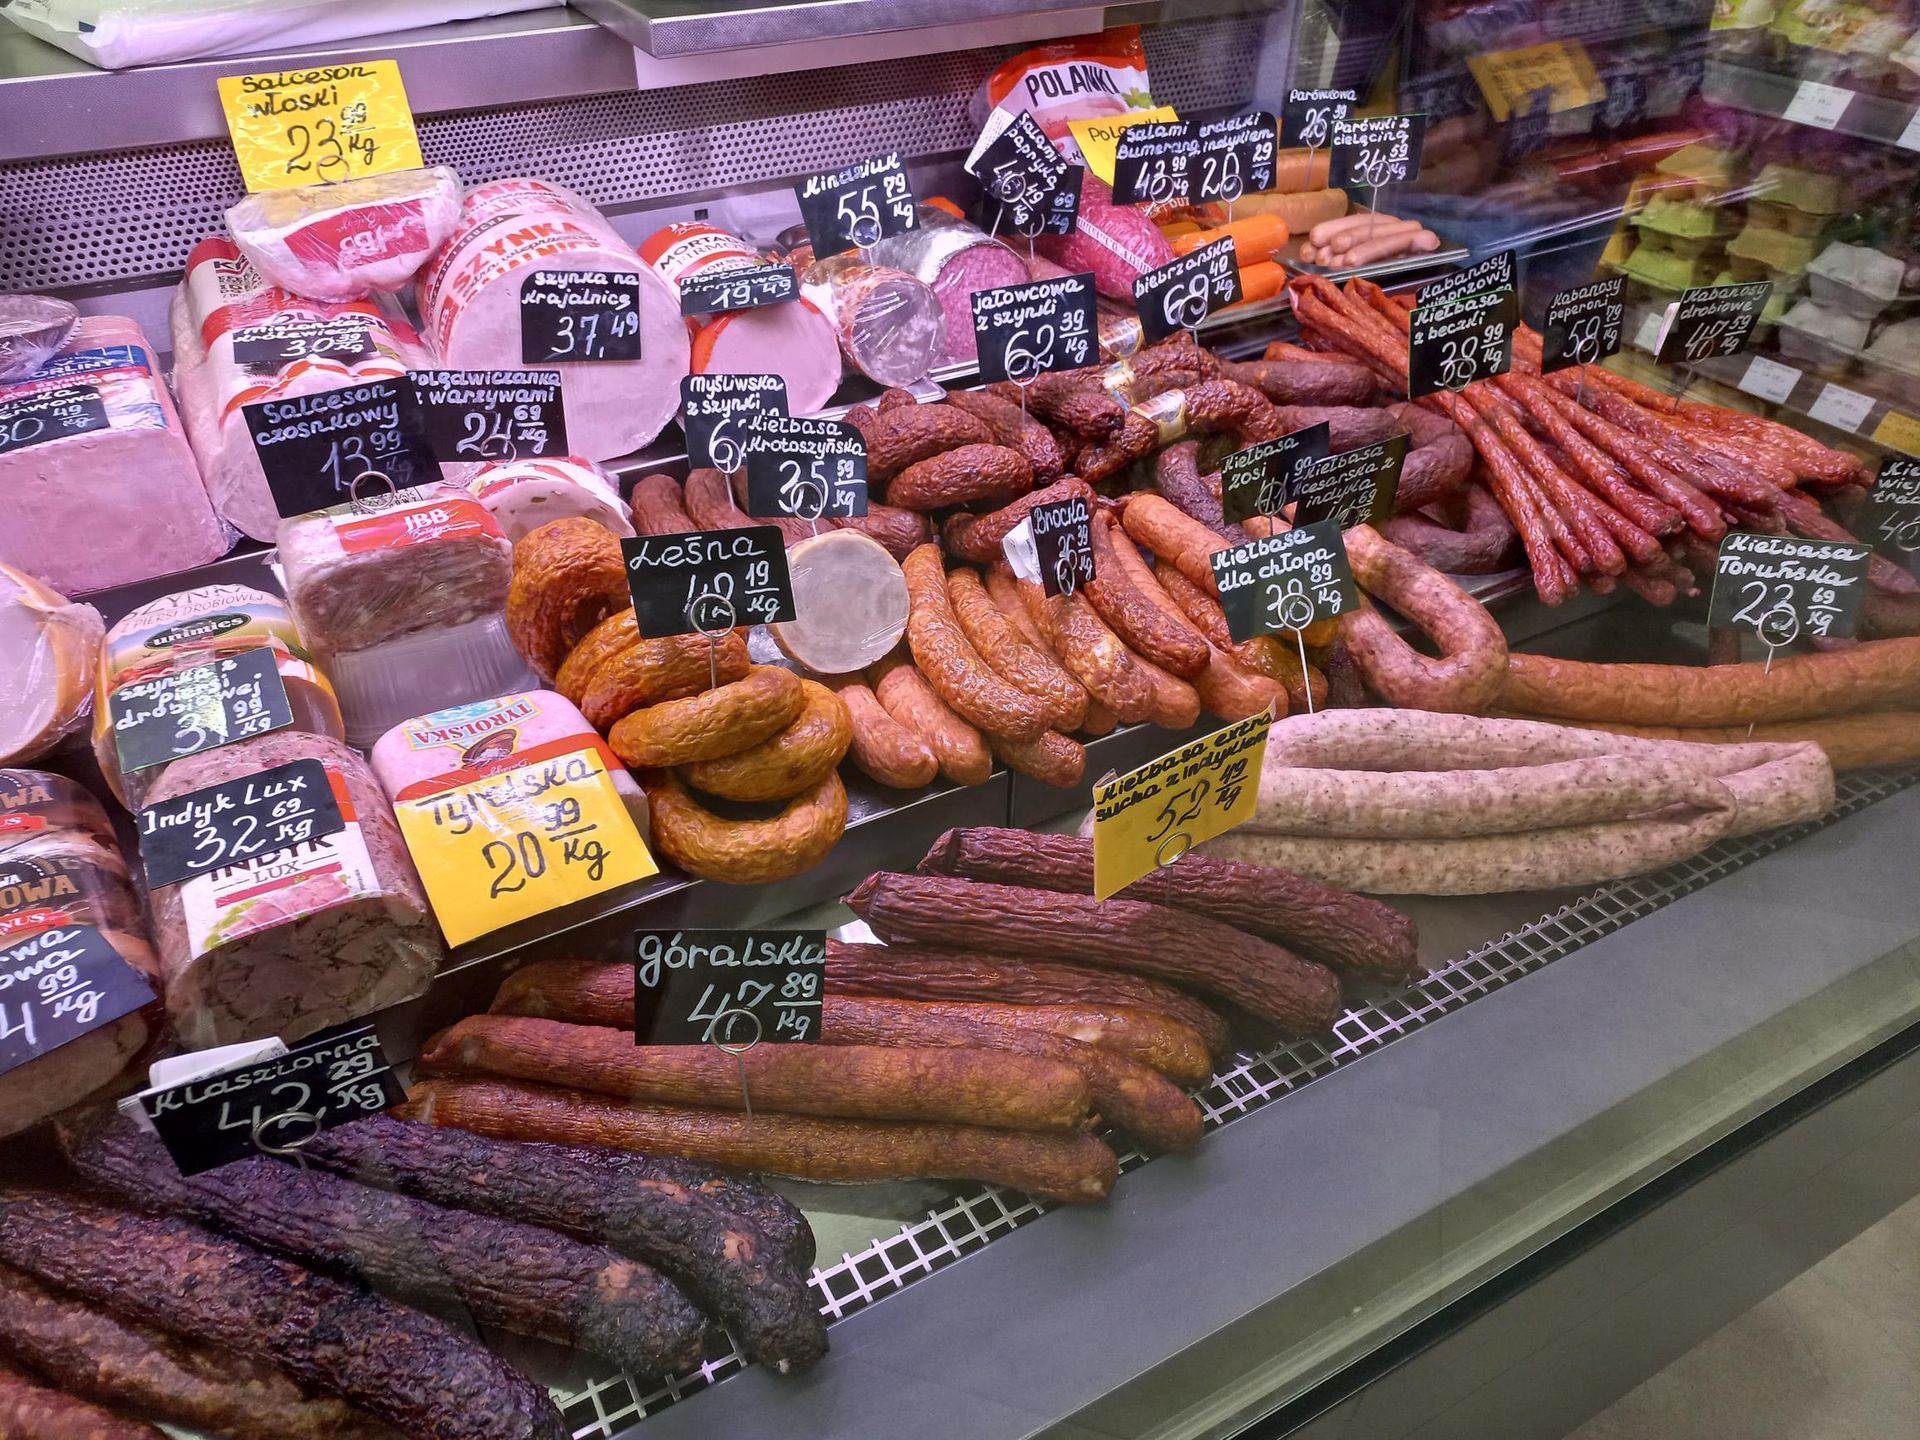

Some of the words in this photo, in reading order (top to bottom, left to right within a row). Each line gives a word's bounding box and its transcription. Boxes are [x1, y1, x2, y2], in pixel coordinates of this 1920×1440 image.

[242, 66, 377, 94] Salceson
[1025, 63, 1121, 107] POLANKI
[1019, 112, 1061, 165] Salami
[1127, 120, 1190, 143] Salami
[1199, 111, 1260, 138] erdelki
[1334, 116, 1397, 134] Parówki
[286, 118, 344, 174] 23
[1117, 140, 1200, 159] Bumerang
[1389, 143, 1409, 158] 59
[883, 173, 906, 198] 79
[1201, 151, 1240, 198] 20
[1253, 142, 1273, 163] 29
[452, 221, 583, 290] SZYNKA
[613, 273, 639, 286] na
[762, 279, 792, 294] 49
[1418, 252, 1509, 303] Kabanosy
[1551, 278, 1622, 308] Kabanosy
[1684, 284, 1768, 304] Kabanosy
[976, 316, 989, 332] z
[993, 299, 1058, 329] szynki
[1163, 273, 1209, 326] 69
[1414, 293, 1505, 327] Kiełbasa
[1548, 294, 1610, 327] peperoni
[1606, 304, 1622, 322] 79
[1680, 300, 1753, 320] drobiowe
[610, 311, 639, 338] 49
[1413, 331, 1424, 346] z
[1428, 311, 1487, 340] beczki
[1484, 323, 1504, 343] 99
[1729, 314, 1752, 330] 59
[1004, 324, 1056, 376] 62
[1059, 309, 1086, 332] 39
[53, 404, 83, 417] 49
[263, 384, 396, 424] Salceson
[429, 386, 555, 410] warzywami
[687, 401, 698, 416] z
[702, 392, 760, 418] szynki
[256, 402, 398, 446] czosnkowy
[370, 430, 402, 451] 99
[456, 412, 513, 454] 24
[514, 404, 542, 421] 69
[748, 415, 842, 436] Kiełbasa
[1223, 436, 1299, 474] Kiełbasa
[1303, 445, 1386, 480] Kiełbasa
[779, 460, 829, 513] 35
[837, 460, 855, 478] 59
[1302, 463, 1378, 495] cesarska
[1381, 456, 1395, 470] z
[1306, 479, 1376, 508] indyka
[629, 536, 767, 571] Leśna
[1213, 529, 1315, 570] Kiełbasa
[1727, 535, 1869, 562] Kiełbasa
[745, 560, 770, 588] 19
[1217, 569, 1255, 593] dla
[1258, 547, 1336, 579] chłopa
[1310, 563, 1332, 583] 89
[1719, 555, 1858, 587] Toruńska
[1731, 580, 1797, 632] 23
[1811, 586, 1836, 605] 69
[413, 697, 534, 745] TYROLSKA
[1097, 743, 1208, 806] Kiełbasa
[1213, 712, 1274, 747] extra
[142, 794, 236, 836] Indyk
[243, 775, 308, 806] Lux
[1096, 784, 1162, 822] sucha
[1166, 773, 1180, 787] z
[1146, 779, 1211, 842] 52
[1219, 757, 1248, 783] 49
[187, 815, 267, 868] 32
[272, 797, 302, 818] 69
[482, 831, 548, 899] 20
[544, 797, 582, 832] 99
[254, 860, 301, 884] LUX
[638, 931, 826, 988] góralska
[38, 965, 78, 997] 99
[687, 979, 776, 1042] 47
[780, 971, 819, 999] 89
[328, 1051, 375, 1082] 29
